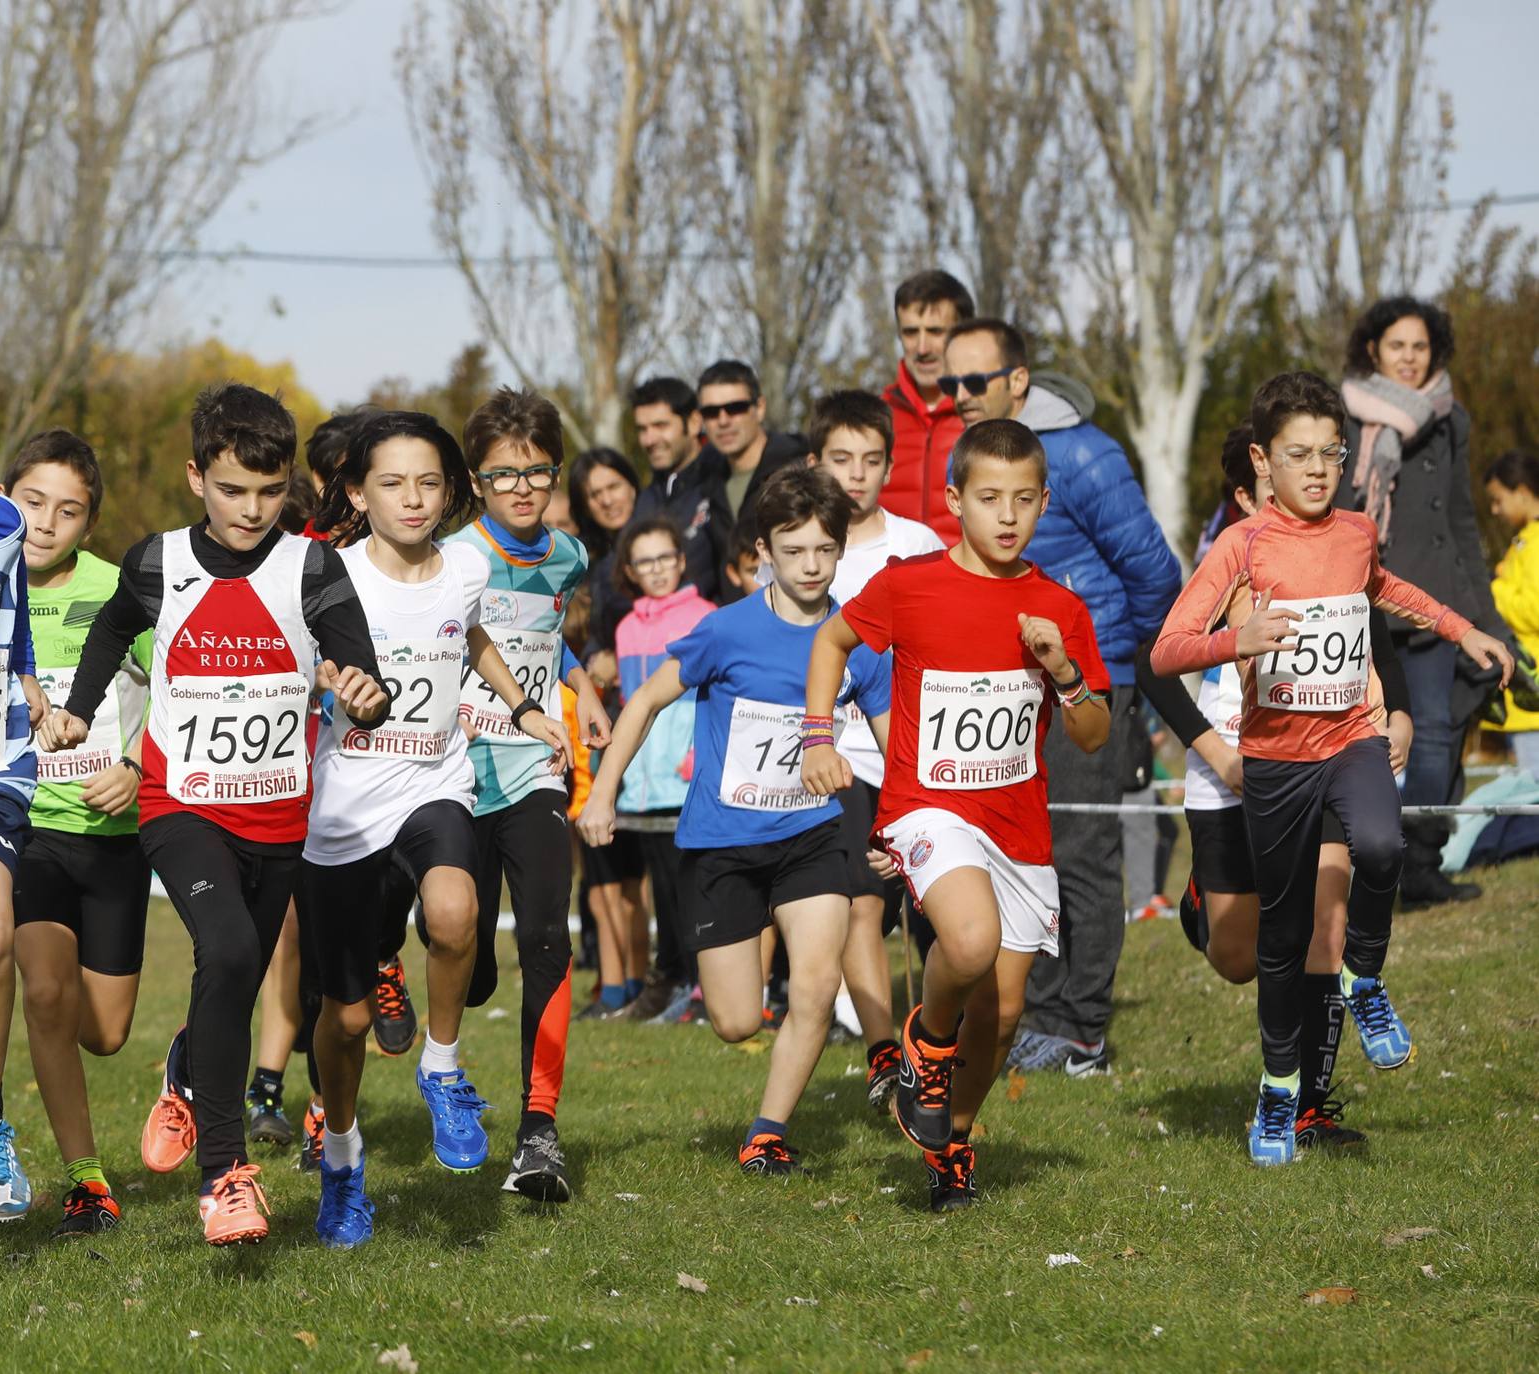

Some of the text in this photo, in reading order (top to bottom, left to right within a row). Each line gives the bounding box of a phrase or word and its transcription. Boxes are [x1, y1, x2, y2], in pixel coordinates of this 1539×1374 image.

[30, 606, 59, 616] oma
[1327, 605, 1367, 618] de La Rioja
[176, 627, 286, 650] AÑARES
[64, 647, 80, 655] ENTR
[523, 643, 532, 651] de
[540, 643, 554, 653] Rioja
[200, 654, 266, 668] RIOJA
[414, 651, 461, 663] de La Rioja
[58, 680, 71, 689] de
[924, 680, 1042, 693] Gobierno de La Rioja
[171, 684, 306, 700] Gobierno de La Rioja
[383, 677, 433, 723] 22
[478, 710, 512, 720] FEDERACIÓ
[738, 710, 782, 723] Gobierno
[474, 716, 524, 737] ATLETI
[928, 702, 1034, 752] 1606
[178, 710, 299, 765] 1592
[376, 729, 417, 739] FEDERACIÓN
[38, 753, 72, 762] EDERACIÓN
[755, 737, 803, 775] 14
[960, 759, 999, 768] FEDERACIÓN
[214, 767, 295, 782] FEDERACIÓN RIOJANA DE
[961, 760, 1028, 783] ATLETISMO
[215, 775, 297, 798] ATLETISMO
